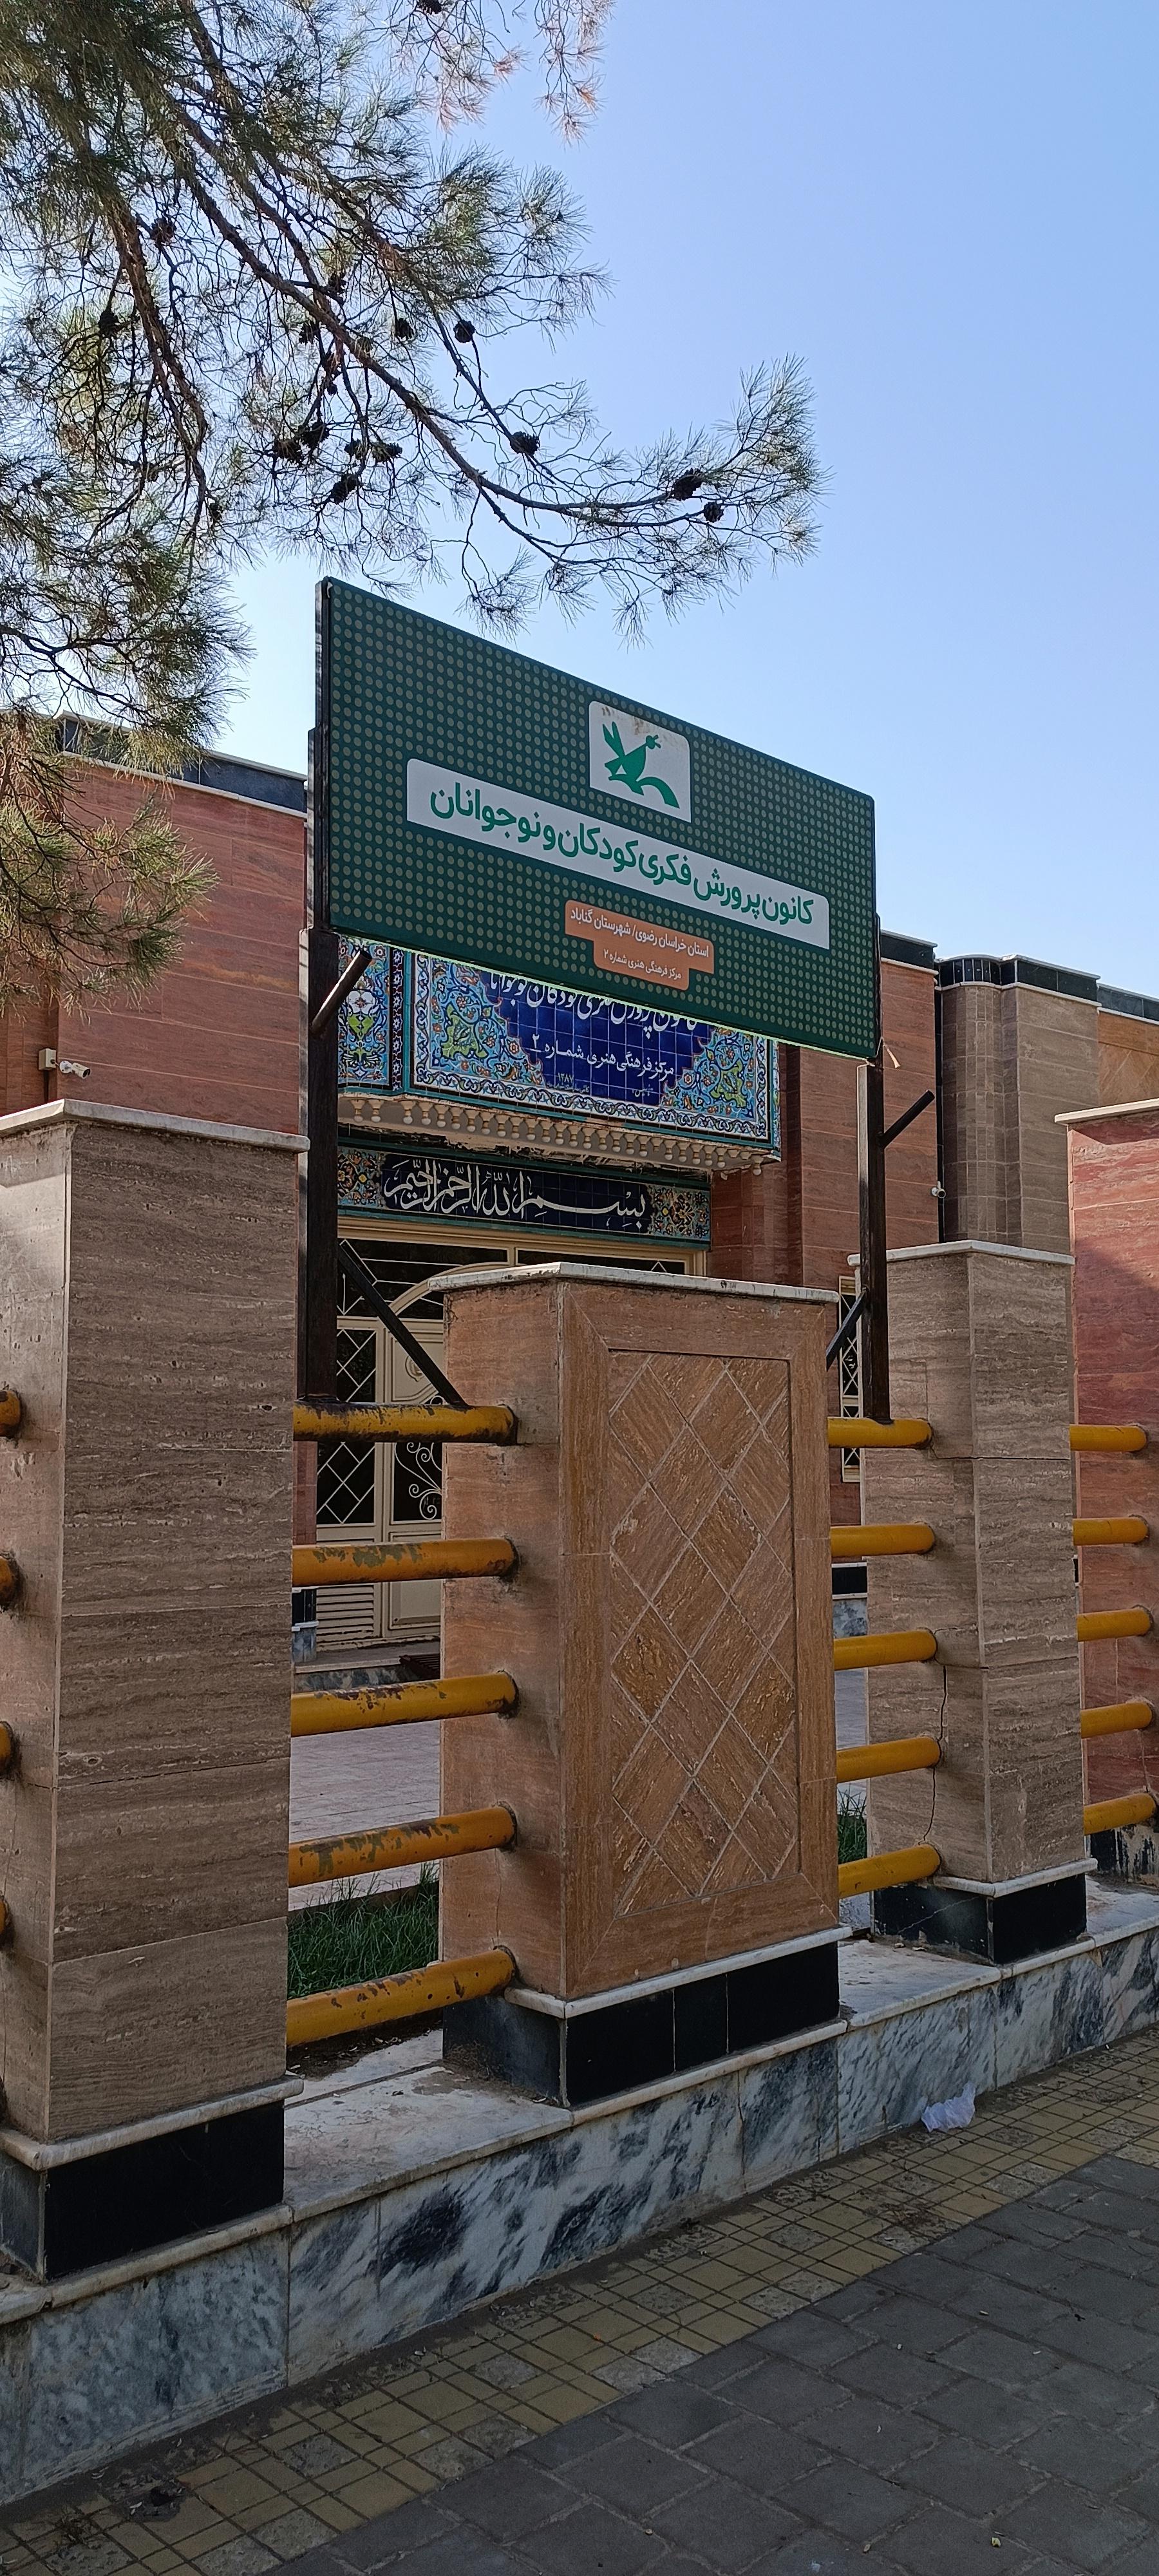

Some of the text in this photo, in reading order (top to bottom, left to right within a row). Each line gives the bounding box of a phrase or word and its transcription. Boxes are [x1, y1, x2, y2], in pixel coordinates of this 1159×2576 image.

[429, 782, 542, 844] نوجوانان
[557, 822, 639, 873] کودکان
[638, 853, 692, 886] فکری
[693, 868, 760, 920] پرورش
[570, 907, 594, 924] گناباد
[762, 895, 815, 925] کانون
[594, 914, 631, 937] شهرستان
[658, 933, 686, 952] خراسان
[687, 942, 710, 958] استان
[609, 952, 627, 965] شماره
[628, 958, 645, 969] هنری
[645, 961, 668, 976] فرهنگی
[668, 967, 682, 980] مرکز
[545, 1039, 584, 1059] شماره
[587, 1052, 616, 1068] هنری
[616, 1051, 652, 1077] فرهنگی
[648, 1061, 674, 1082] مرکز
